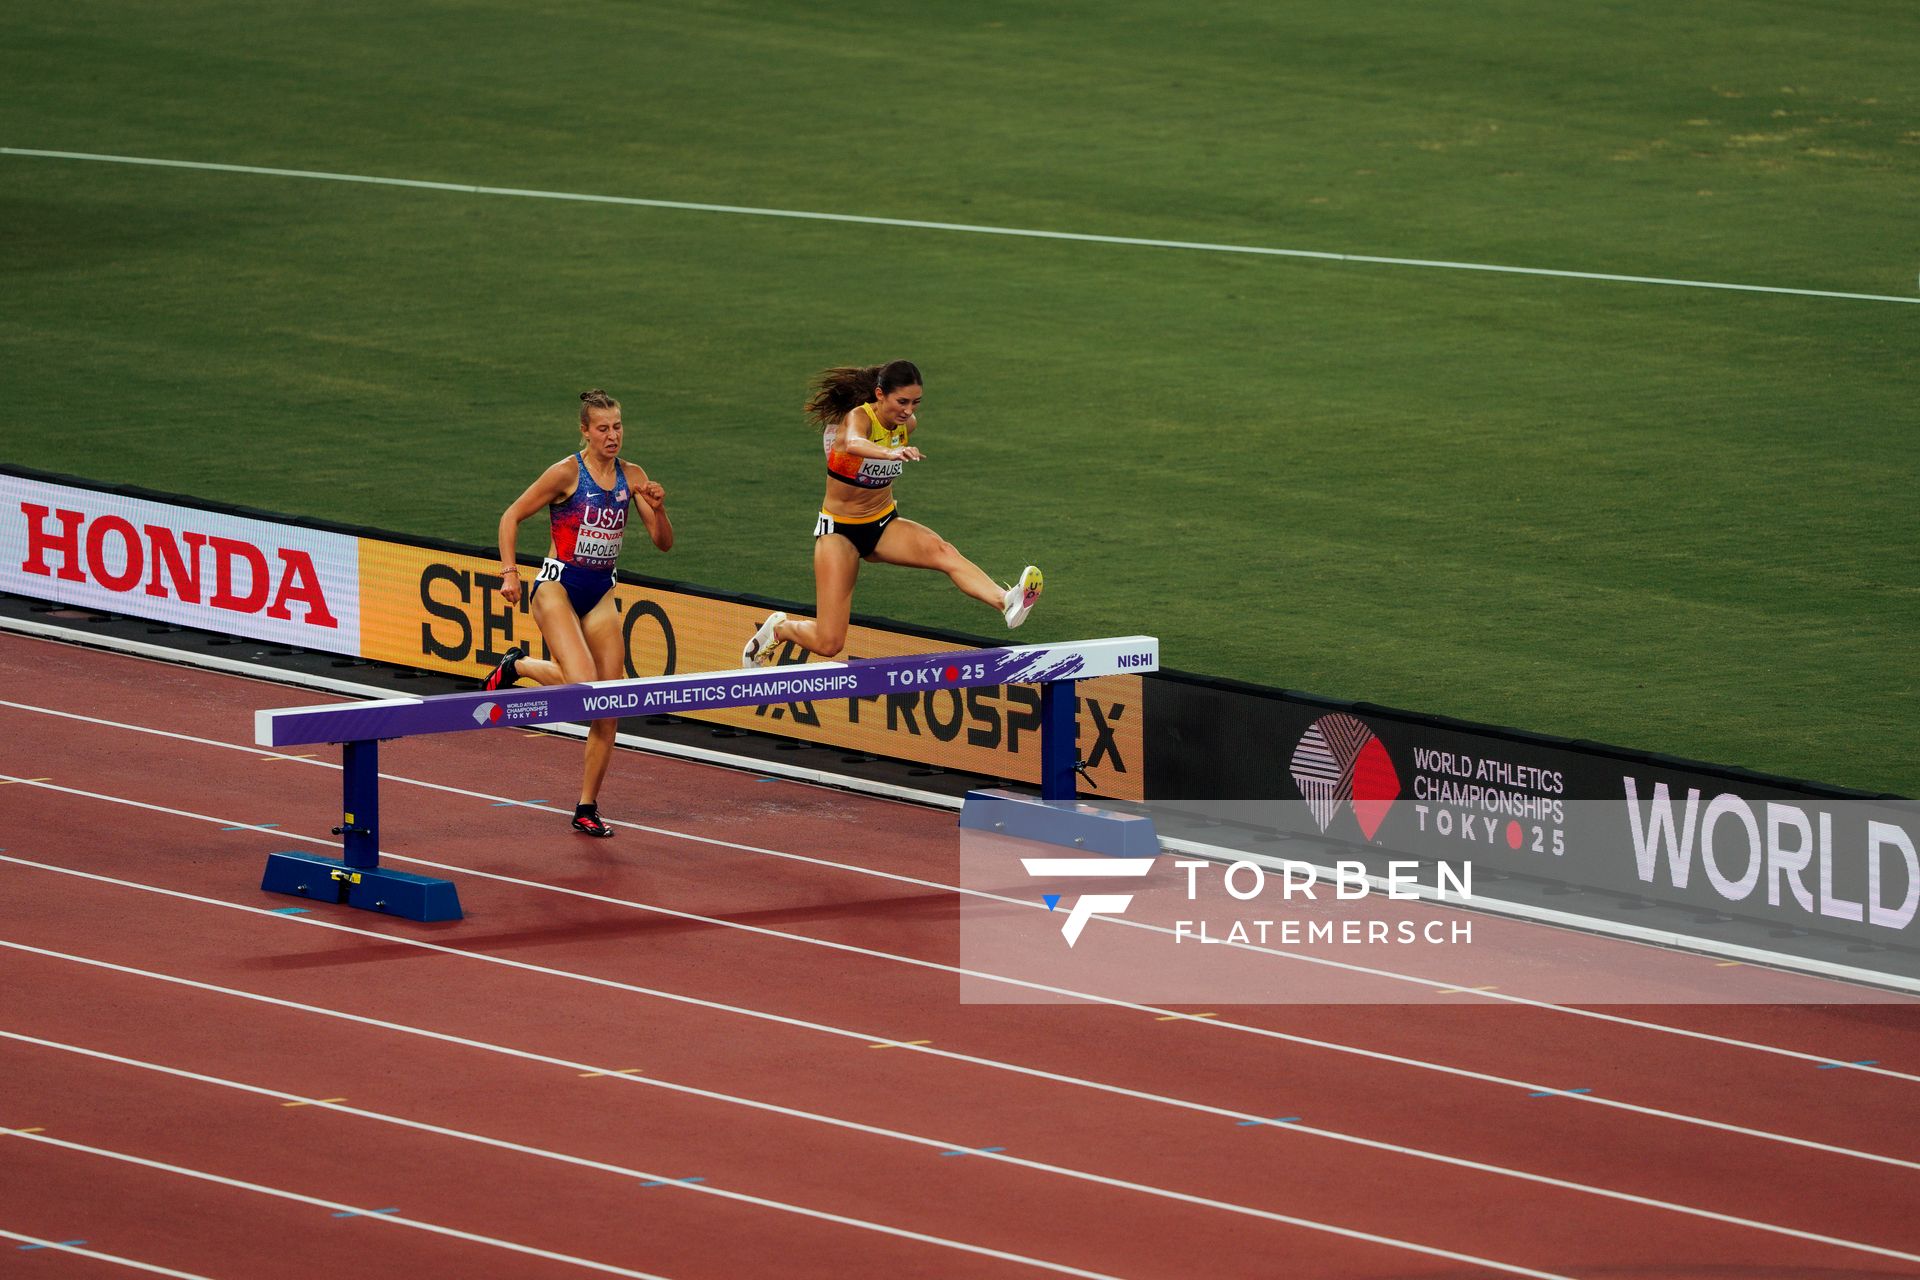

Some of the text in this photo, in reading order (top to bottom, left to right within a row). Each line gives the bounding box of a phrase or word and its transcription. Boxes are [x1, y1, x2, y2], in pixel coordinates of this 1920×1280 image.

[863, 462, 901, 477] KRAUSE
[584, 505, 625, 529] USA
[580, 528, 623, 540] HONDA
[20, 502, 339, 629] HONDA
[541, 562, 560, 581] 10
[420, 563, 677, 679] SEO
[1117, 653, 1153, 668] NISHI
[583, 675, 858, 712] WORLD ATHLETICS CHAMPIONSHIPS
[507, 705, 548, 714] CHAMPIONSHIPS
[1413, 747, 1564, 794] WORLD ATHLETICS
[1413, 775, 1565, 824] CHAMPIONSHIPS
[1623, 776, 1920, 930] WORLD
